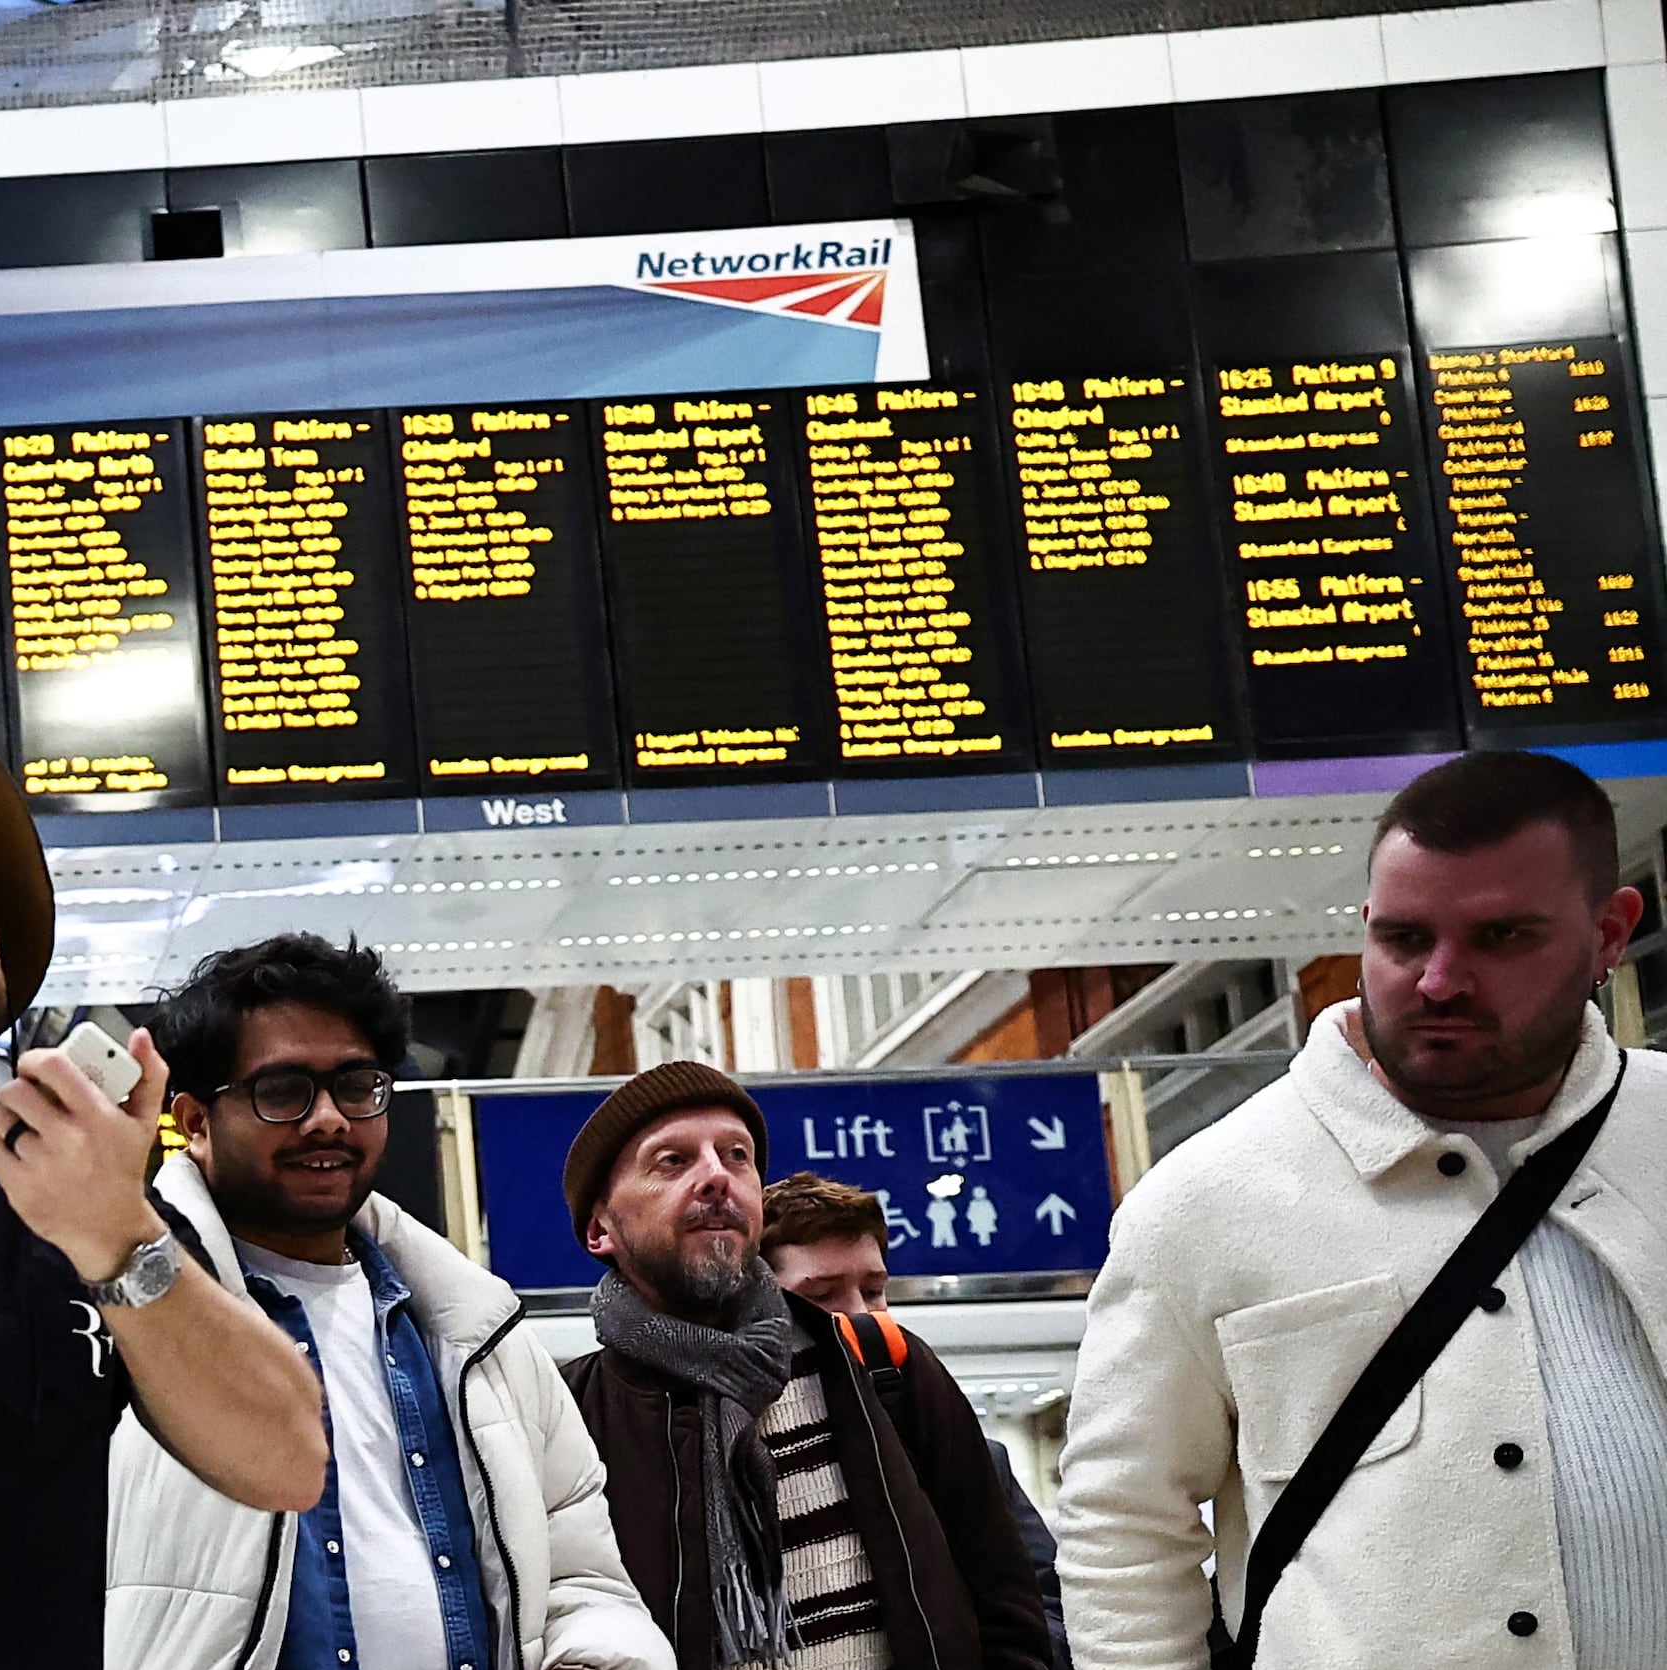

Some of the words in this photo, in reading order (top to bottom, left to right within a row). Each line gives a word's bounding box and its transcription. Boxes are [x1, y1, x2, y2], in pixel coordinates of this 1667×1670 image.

[636, 238, 892, 278] NetworkRail
[1293, 363, 1375, 385] Platform
[1083, 376, 1165, 398] Platform
[674, 400, 753, 422] Platform
[877, 389, 957, 411] Platform
[1220, 391, 1309, 416] Stansted
[1314, 387, 1385, 411] Airport
[274, 419, 352, 441] Platform
[472, 410, 550, 431] Platform
[72, 431, 150, 453] Platform
[1306, 468, 1389, 490] Platform
[1234, 497, 1323, 521] Stansted
[1328, 492, 1401, 516] Airport
[1321, 574, 1404, 596] Platform
[1247, 603, 1337, 628] Stansted
[1342, 600, 1414, 624] Airport
[481, 798, 567, 826] West
[803, 1114, 896, 1160] Lift
